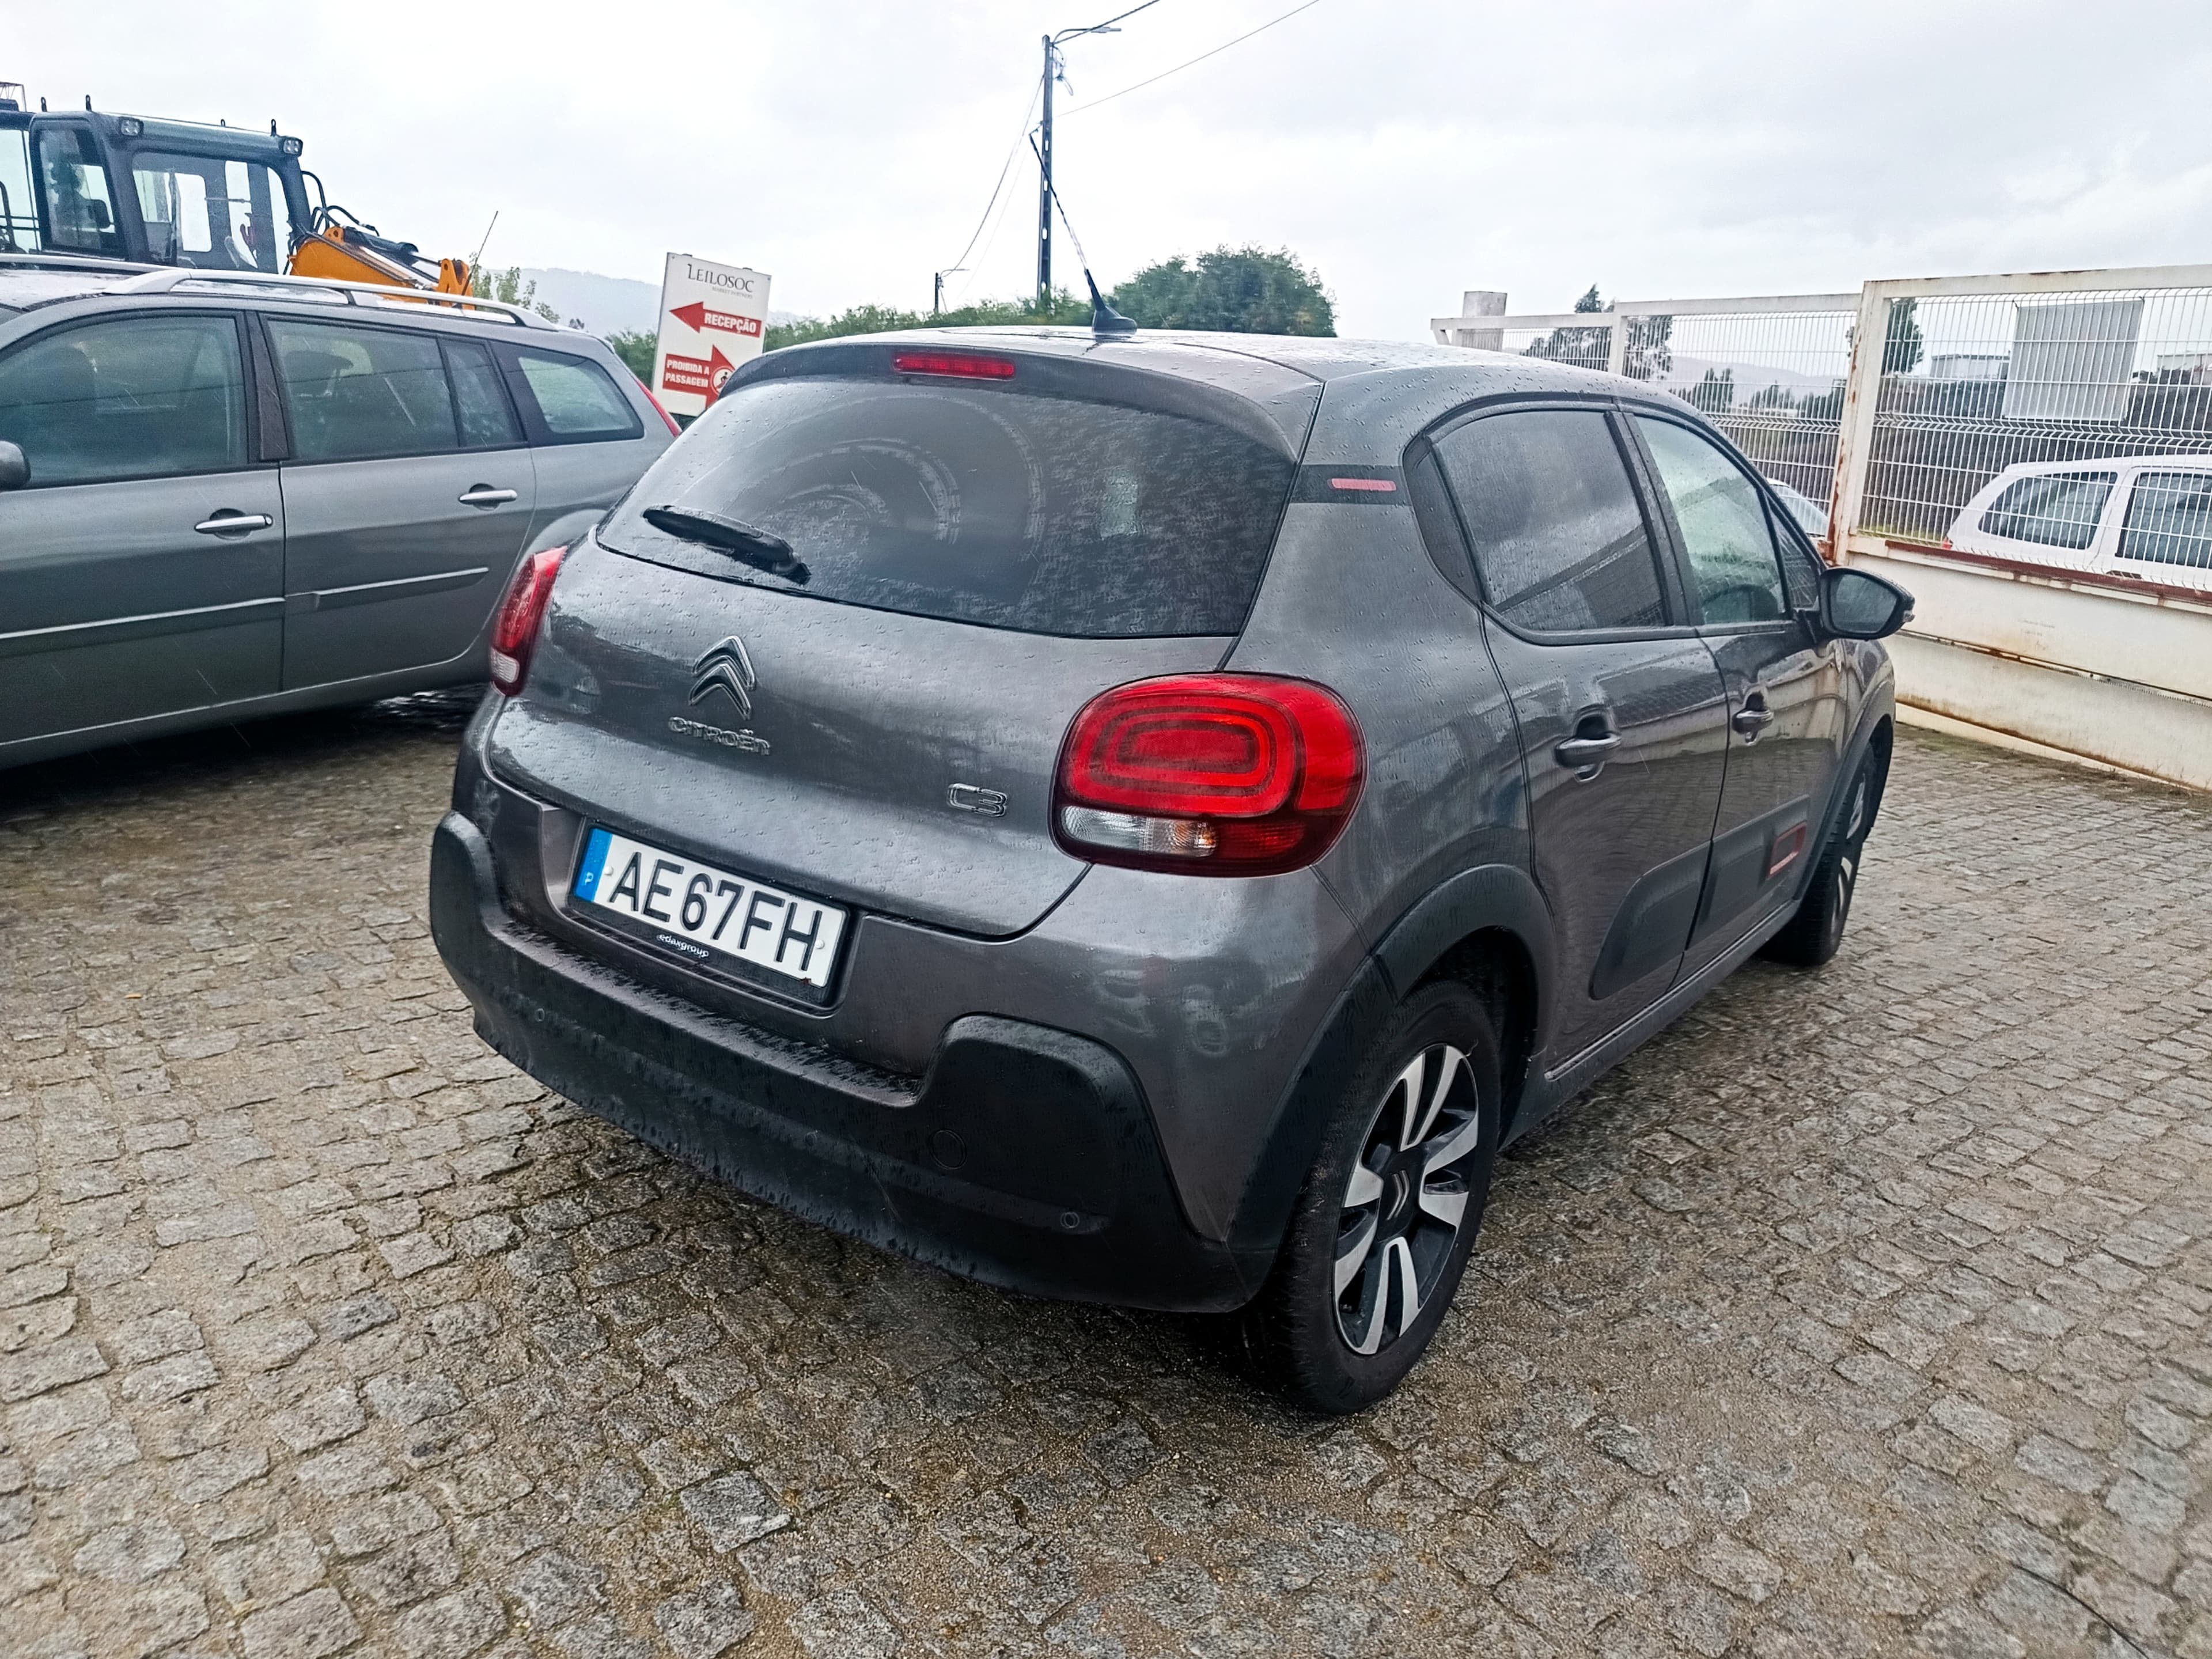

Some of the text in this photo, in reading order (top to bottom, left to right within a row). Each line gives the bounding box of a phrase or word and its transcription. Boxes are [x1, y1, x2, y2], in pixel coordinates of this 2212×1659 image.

[687, 263, 754, 293] LEILOSOC
[704, 313, 756, 333] RECEPÇÃO
[666, 359, 710, 375] PROIBIDA A
[665, 372, 709, 388] PASSAGEM
[946, 782, 1007, 817] C3
[584, 872, 594, 885] P
[608, 851, 823, 971] AE67FH
[657, 934, 709, 958] edaxgroup
